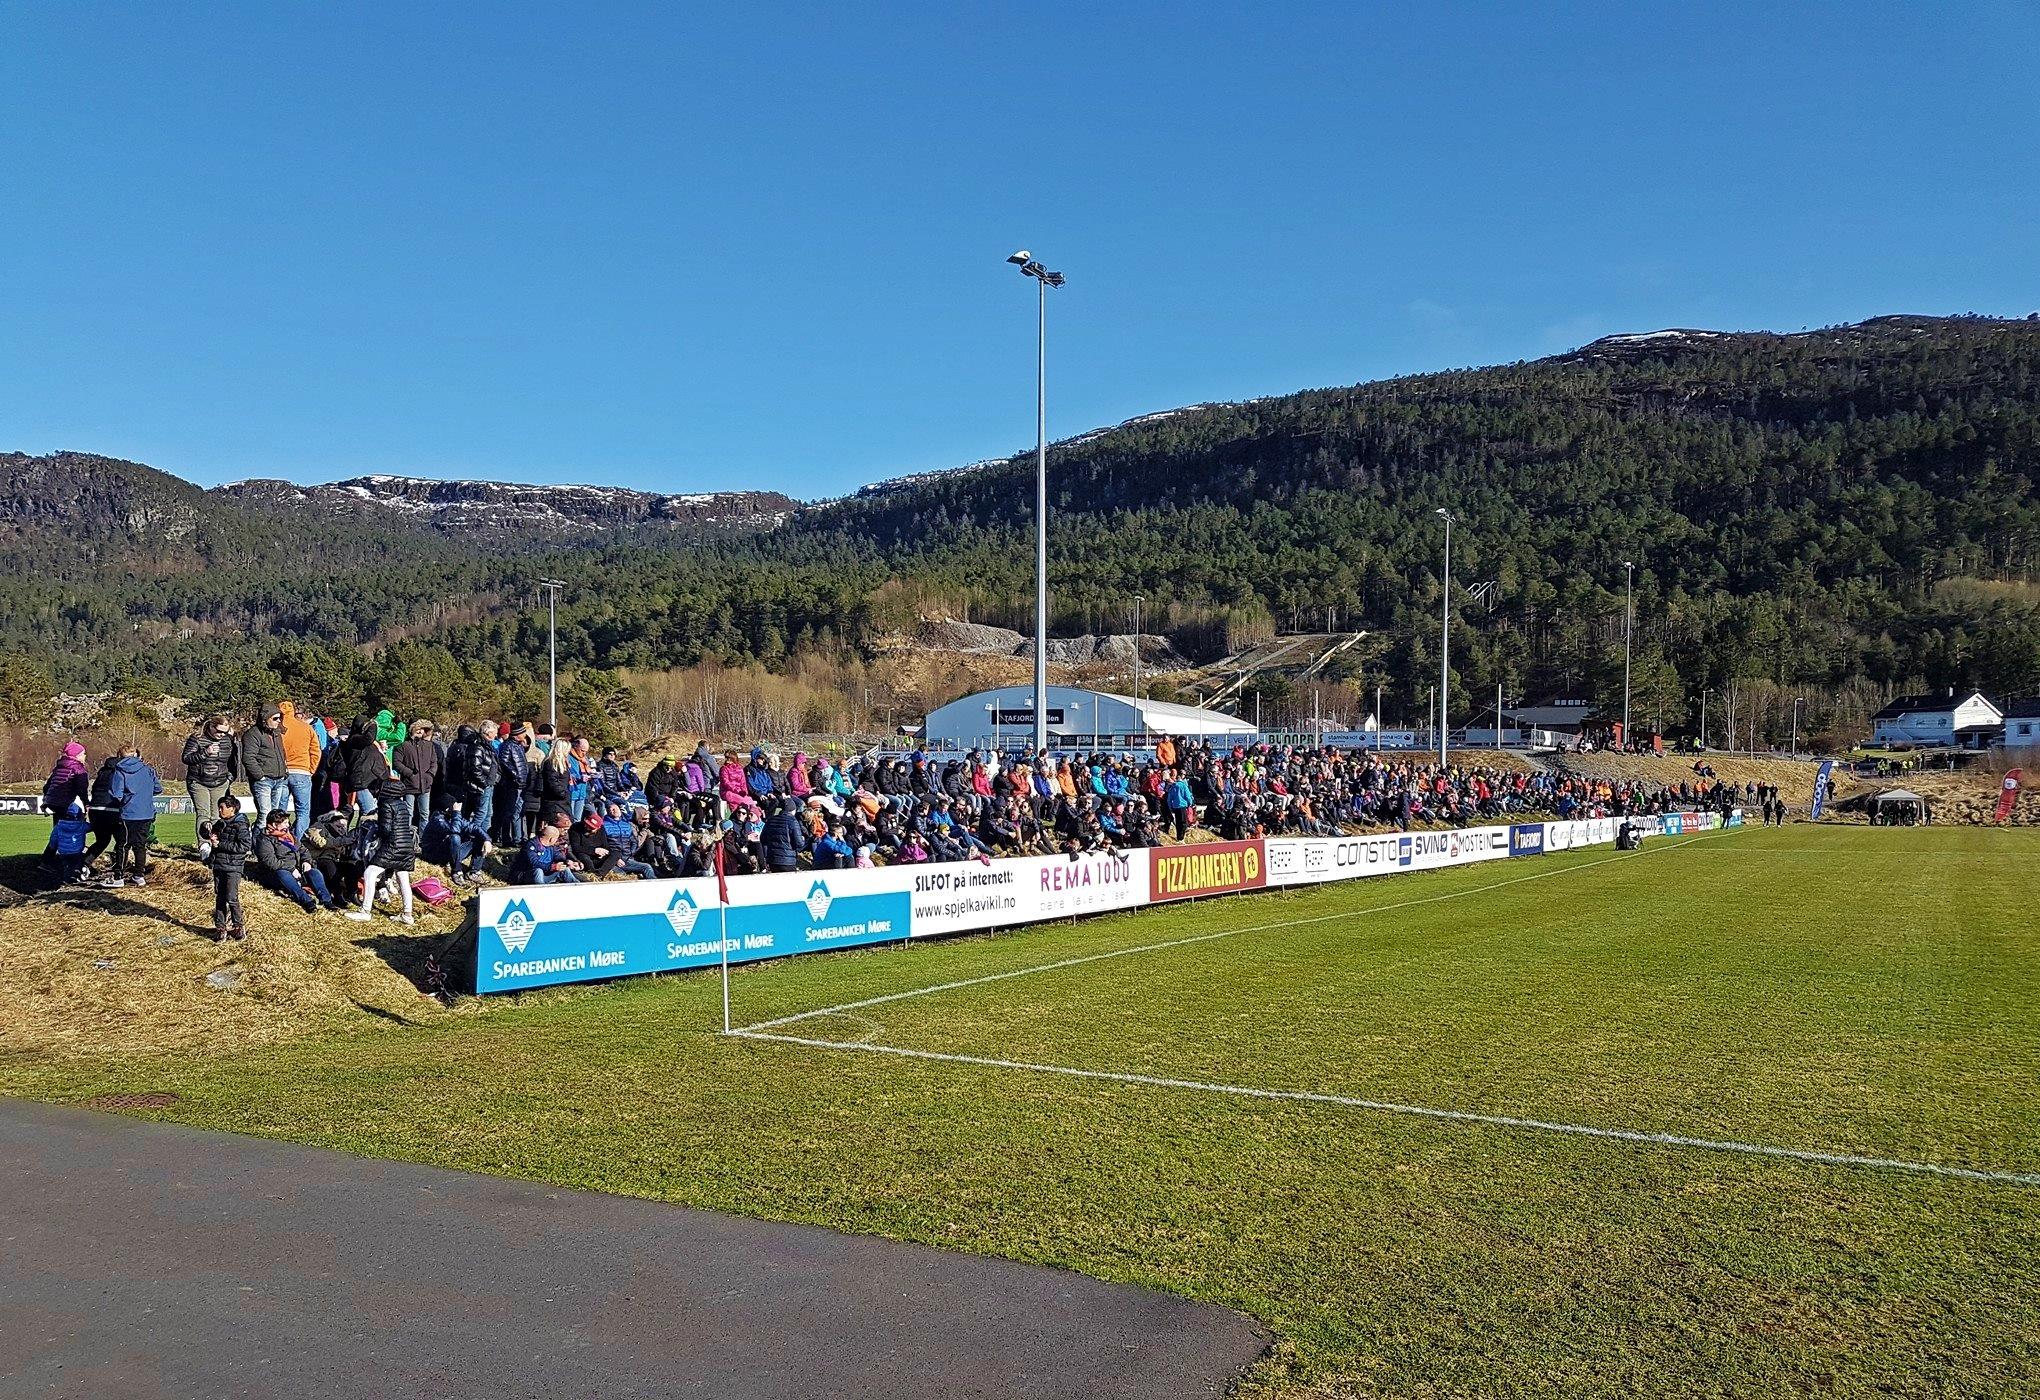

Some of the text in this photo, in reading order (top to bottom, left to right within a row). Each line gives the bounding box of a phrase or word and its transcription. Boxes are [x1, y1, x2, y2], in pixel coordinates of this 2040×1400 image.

[1004, 714, 1060, 722] TAFJORDllen
[1268, 733, 1323, 744] BUNNPRS
[1372, 733, 1393, 741] stmina
[915, 869, 1014, 892] SILFOT på internett:
[1040, 860, 1129, 892] REMA 1000
[1157, 851, 1241, 894] PIZZABAKEREN
[915, 895, 1016, 919] www.spjelkavikil.no
[744, 933, 774, 950] MØRE
[492, 950, 626, 980] SPAREBANKEN MØRE
